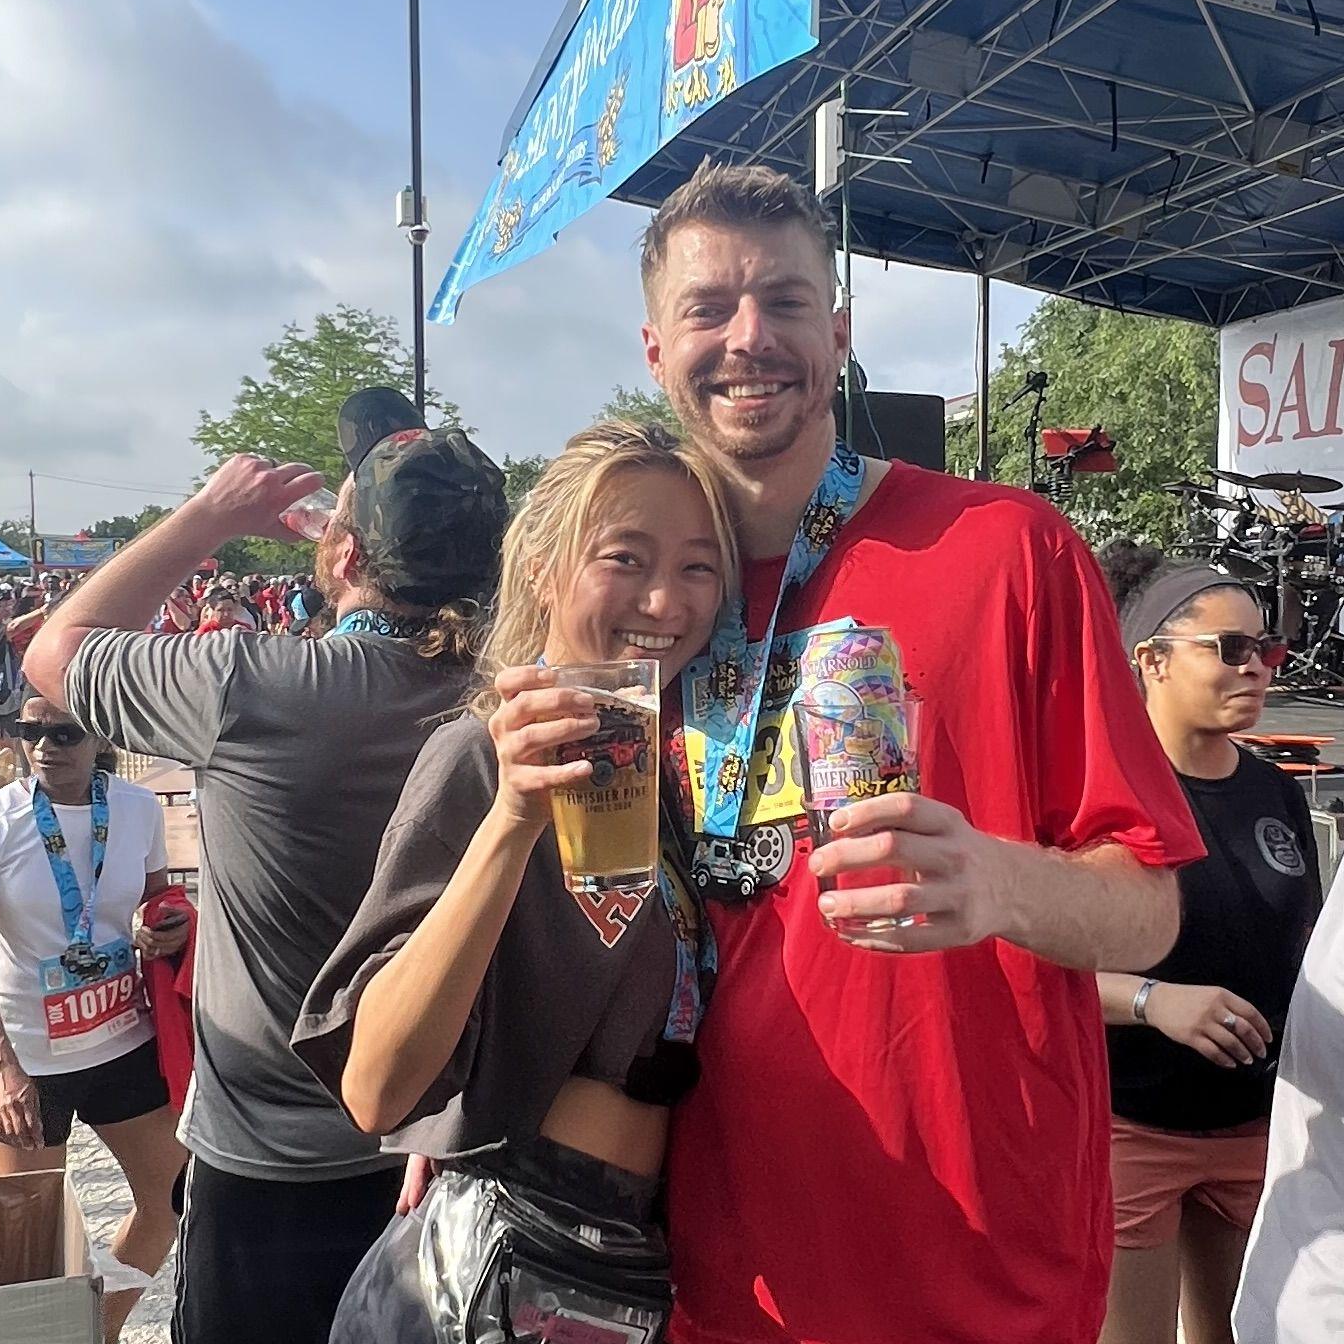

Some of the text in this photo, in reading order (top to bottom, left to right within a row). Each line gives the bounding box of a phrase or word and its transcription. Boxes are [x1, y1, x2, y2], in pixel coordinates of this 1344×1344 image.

[848, 779, 887, 797] ART
[46, 1002, 65, 1026] 10K
[64, 974, 134, 1024] 10179
